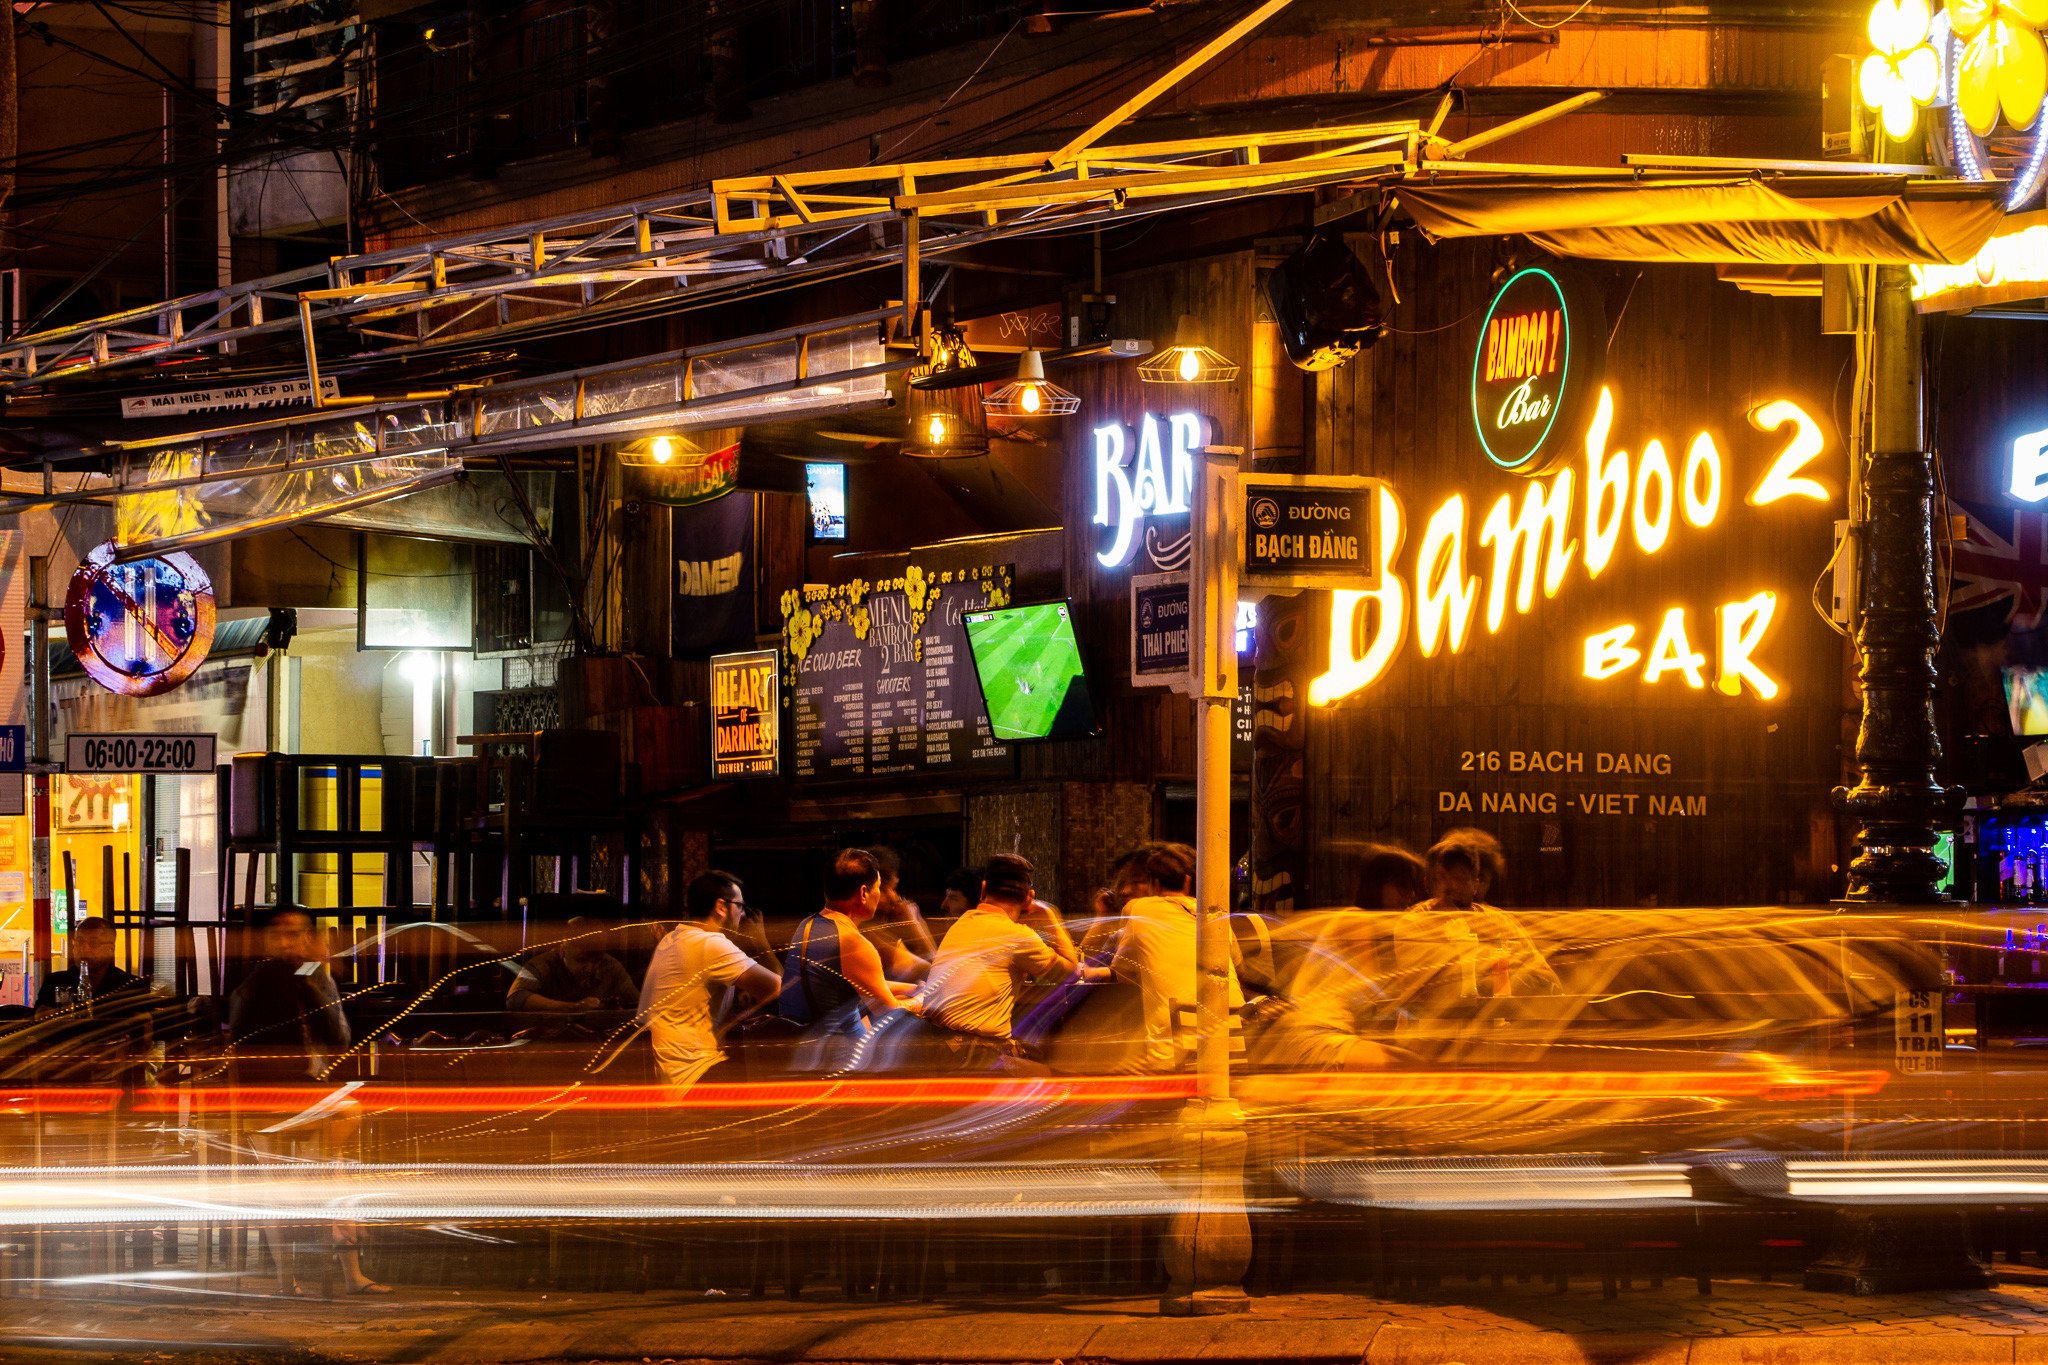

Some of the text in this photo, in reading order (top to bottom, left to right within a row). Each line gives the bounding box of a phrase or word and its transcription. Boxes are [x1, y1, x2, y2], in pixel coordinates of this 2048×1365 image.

[1486, 309, 1561, 382] BAMBOO 2
[180, 391, 211, 404] HIÊN
[299, 379, 333, 392] ĐNG
[1497, 375, 1551, 429] Bar
[1093, 411, 1200, 568] BAR
[1289, 502, 1351, 520] ĐƯỜNG
[1256, 529, 1358, 563] BẠCH ĐẰNG
[1308, 386, 1830, 707] Bamboo 2
[868, 594, 912, 628] MENU
[1158, 600, 1188, 620] ĐƯỜNG
[869, 622, 914, 648] BAMBOO
[1142, 625, 1163, 658] THÁI
[1583, 592, 1778, 700] BAR
[813, 651, 835, 672] COLD
[836, 648, 862, 671] BEER
[881, 641, 915, 674] 2 BAR
[717, 666, 771, 714] HEART
[796, 686, 823, 696] LOCAL BEER
[877, 676, 911, 695] SHOOTERS
[834, 693, 864, 703] EXPORT BEER
[741, 709, 748, 723] OF
[941, 710, 952, 719] MARY
[718, 722, 772, 754] DARKNESS
[85, 739, 196, 769] 06:00-22:00
[798, 759, 810, 767] CIDER
[852, 756, 864, 764] BEER
[1461, 751, 1672, 775] 216 BACH DANG
[719, 760, 773, 774] BREWERY SAIGON
[1439, 791, 1473, 812] DA
[1482, 792, 1557, 814] NANG
[1580, 793, 1640, 815] VIET
[1649, 795, 1708, 816] NAM
[1909, 991, 1930, 1008] CS
[1907, 1012, 1932, 1033] 11
[1899, 1037, 1941, 1052] TBA
